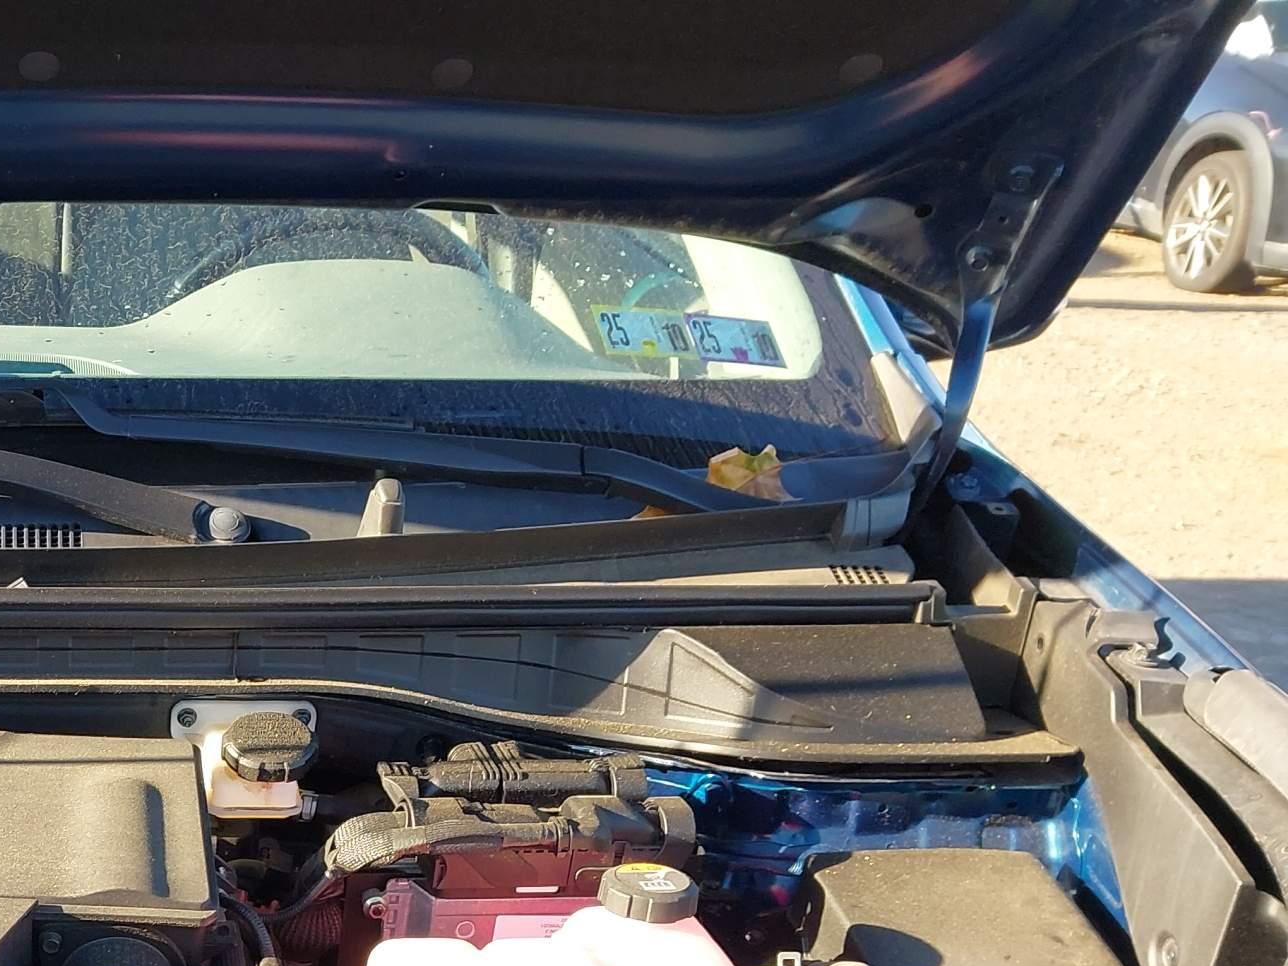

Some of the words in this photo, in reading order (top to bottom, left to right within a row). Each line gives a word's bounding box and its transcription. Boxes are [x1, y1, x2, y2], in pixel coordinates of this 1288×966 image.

[600, 312, 630, 347] 25
[662, 322, 689, 352] 10
[692, 319, 722, 354] 25
